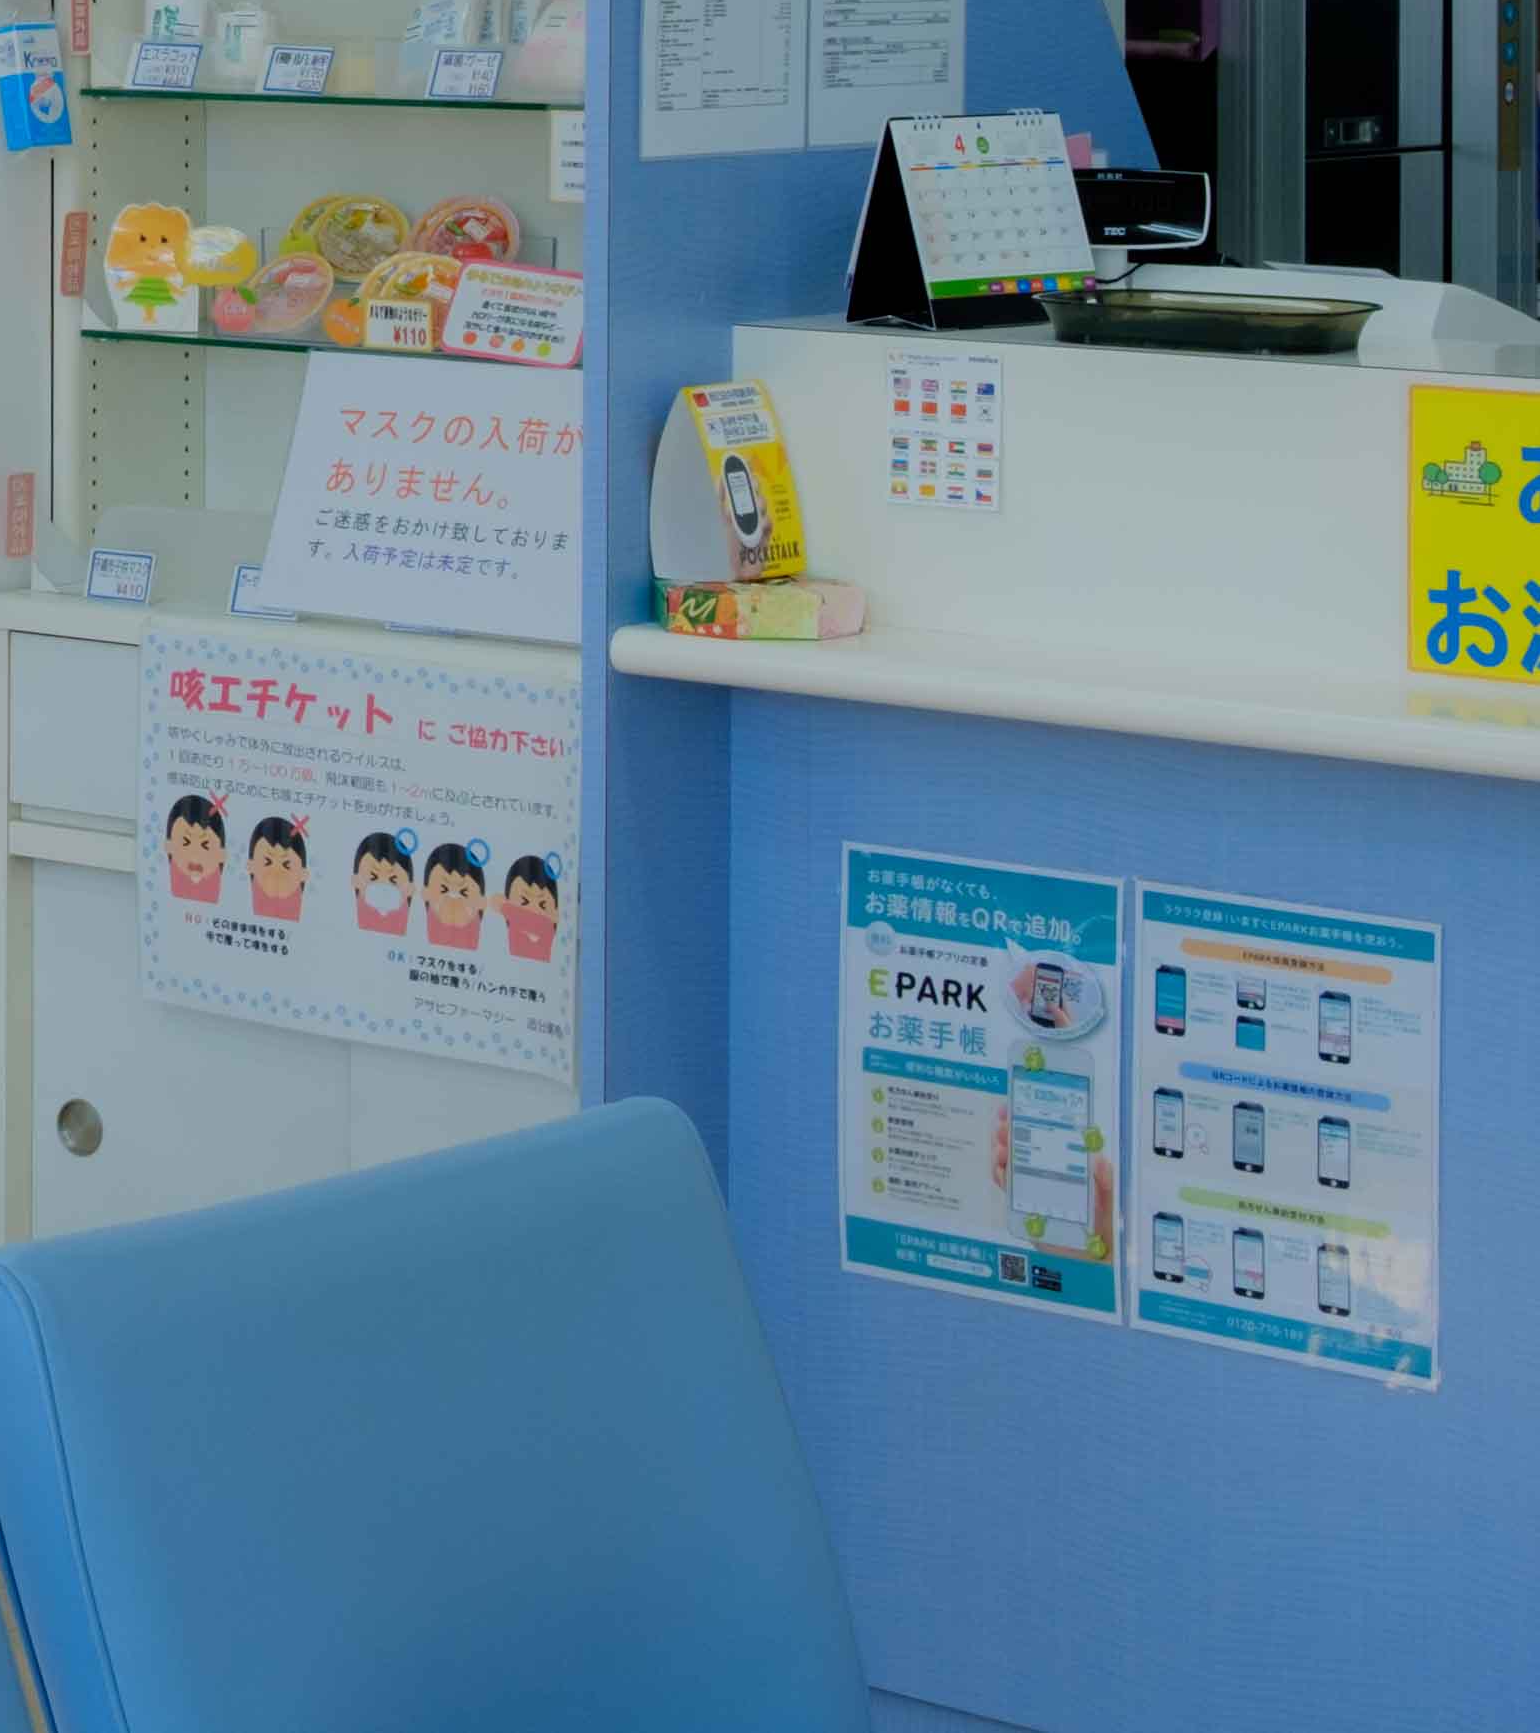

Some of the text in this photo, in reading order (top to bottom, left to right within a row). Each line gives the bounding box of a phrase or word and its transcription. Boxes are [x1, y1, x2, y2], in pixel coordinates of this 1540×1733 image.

[392, 325, 427, 346] ¥110
[340, 406, 584, 457] マスクの入荷が
[325, 459, 511, 510] ありません。
[315, 509, 570, 552] ご迷惑をおかけ致しておりま
[308, 538, 520, 580] す。入荷予定は未定です。
[169, 668, 565, 759] 咳エチケット に ご協力下さい
[869, 1011, 987, 1058] お薬手帳
